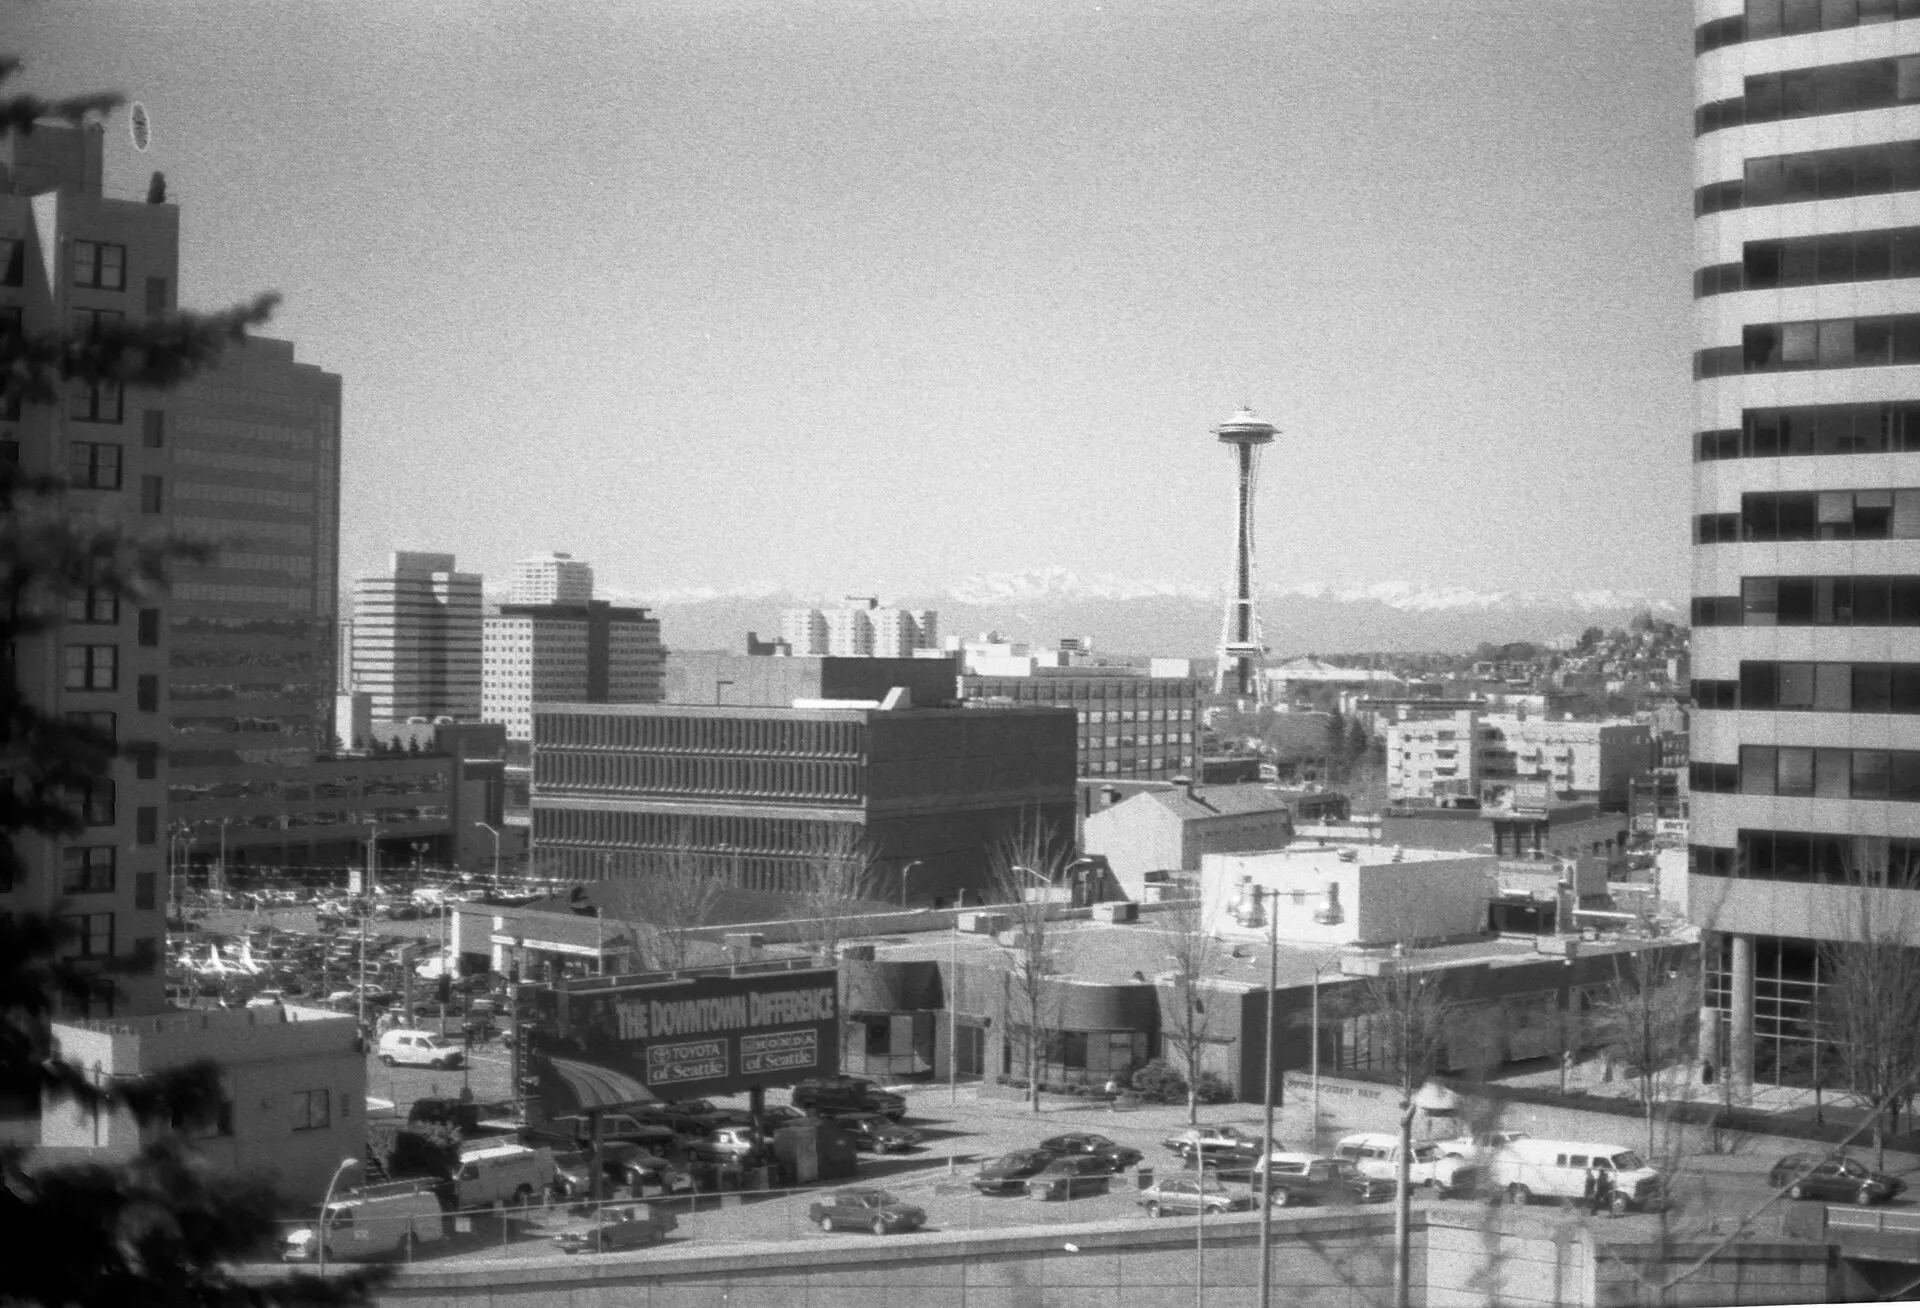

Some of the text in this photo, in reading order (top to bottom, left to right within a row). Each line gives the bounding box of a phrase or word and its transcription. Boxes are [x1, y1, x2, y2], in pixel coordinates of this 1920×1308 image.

[616, 988, 835, 1040] THE DOWNTOWN DIFFERENCE
[672, 1043, 721, 1060] TOYOTA
[755, 1034, 816, 1050] HONDA
[653, 1060, 724, 1082] of Seattle
[746, 1049, 812, 1071] of Seattle
